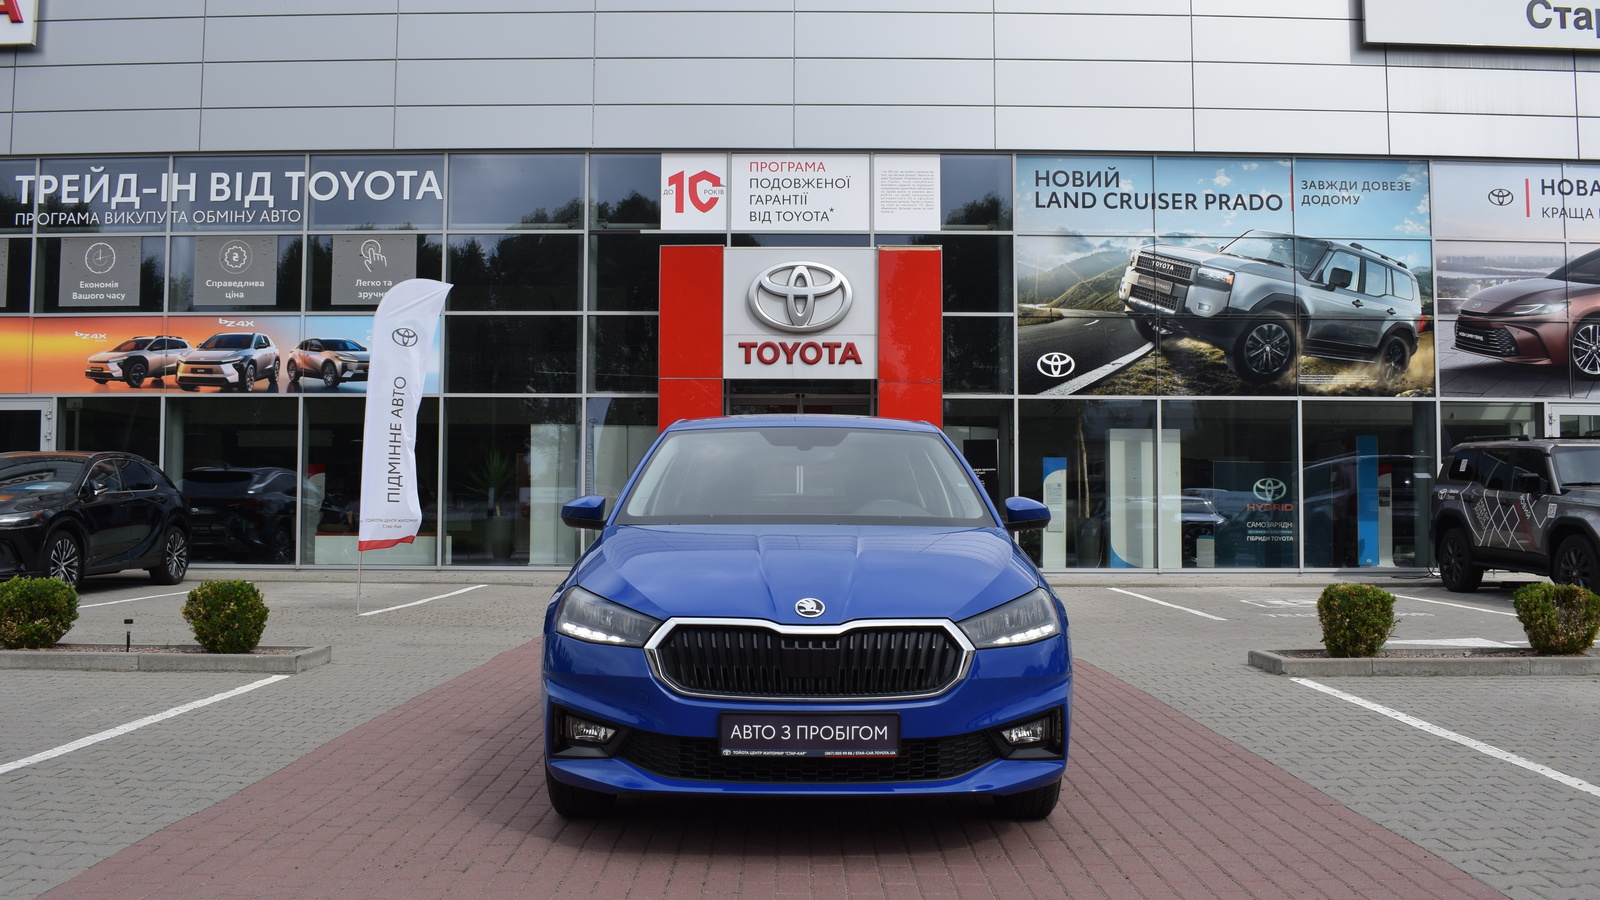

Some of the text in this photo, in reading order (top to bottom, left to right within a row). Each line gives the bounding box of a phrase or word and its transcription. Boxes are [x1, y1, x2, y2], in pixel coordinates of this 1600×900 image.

[1526, 0, 1600, 39] Ста
[749, 161, 826, 173] ПРОГРАМА
[749, 176, 852, 191] ПОДОВЖЕНОЇ
[1035, 166, 1120, 188] НОВИЙ
[15, 166, 444, 210] ТРЕЙД-ІН ВІД TOYOTA
[663, 188, 674, 196] ДО
[703, 188, 725, 196] РОКІВ
[1301, 180, 1411, 193] ЗАВЖДИ ДОВЕЗЕ
[1541, 178, 1600, 197] НОВА
[749, 192, 809, 206] ГАРАНТІЇ
[1035, 191, 1283, 212] LAND CRUISER PRADO
[1301, 194, 1361, 207] ДОДОМУ
[15, 209, 301, 226] ПРОГРАМА ВИКУПУ ТА ОБМІНУ АВТО
[749, 211, 772, 224] ВІД
[1541, 206, 1594, 221] КРАЩА
[1152, 260, 1174, 271] TOYOTA
[79, 280, 119, 289] Економія
[205, 279, 265, 289] Справедлива
[355, 279, 382, 287] Легко
[72, 292, 126, 301] Вашого часу
[225, 290, 245, 300] ціна
[738, 341, 863, 365] TOYOTA
[387, 376, 407, 503] ПІДМІННЕ АВТО
[1246, 503, 1294, 512] HYBRID
[730, 724, 888, 741] АВТО З ПРОБІГОМ
